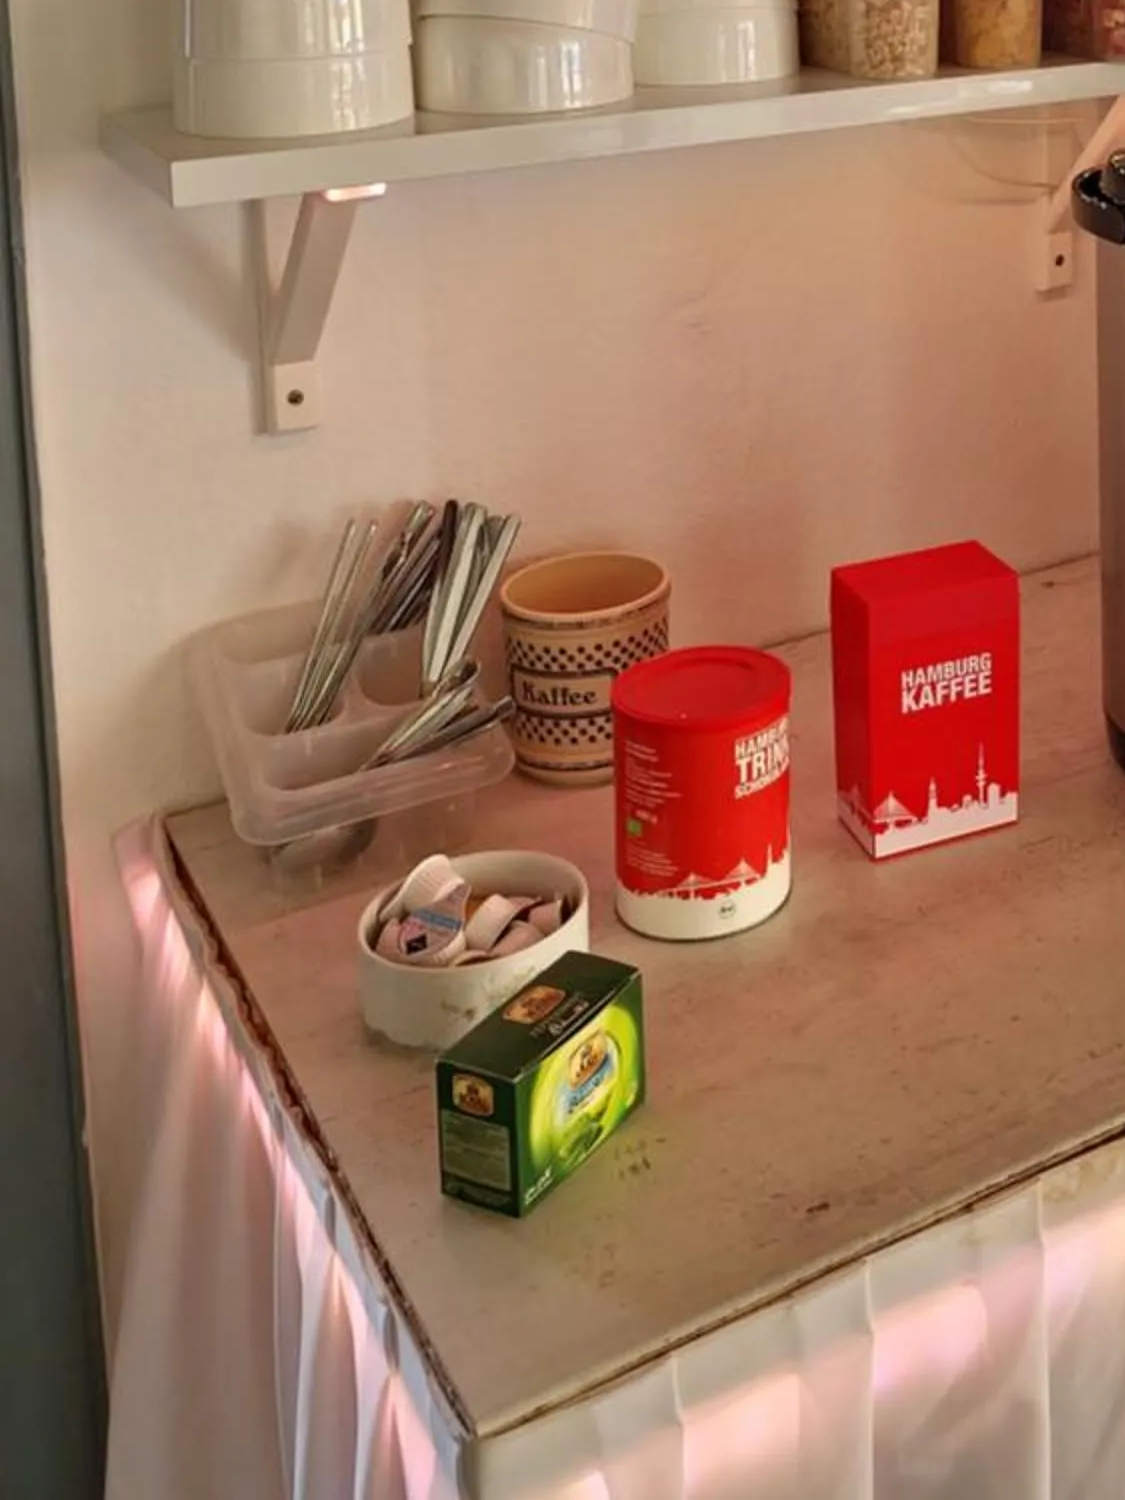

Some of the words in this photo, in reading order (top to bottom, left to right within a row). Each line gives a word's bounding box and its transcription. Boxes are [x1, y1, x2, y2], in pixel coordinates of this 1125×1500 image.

[901, 651, 992, 690] HAMBURG
[522, 680, 597, 706] Kaffee
[901, 670, 993, 715] KAFFEE
